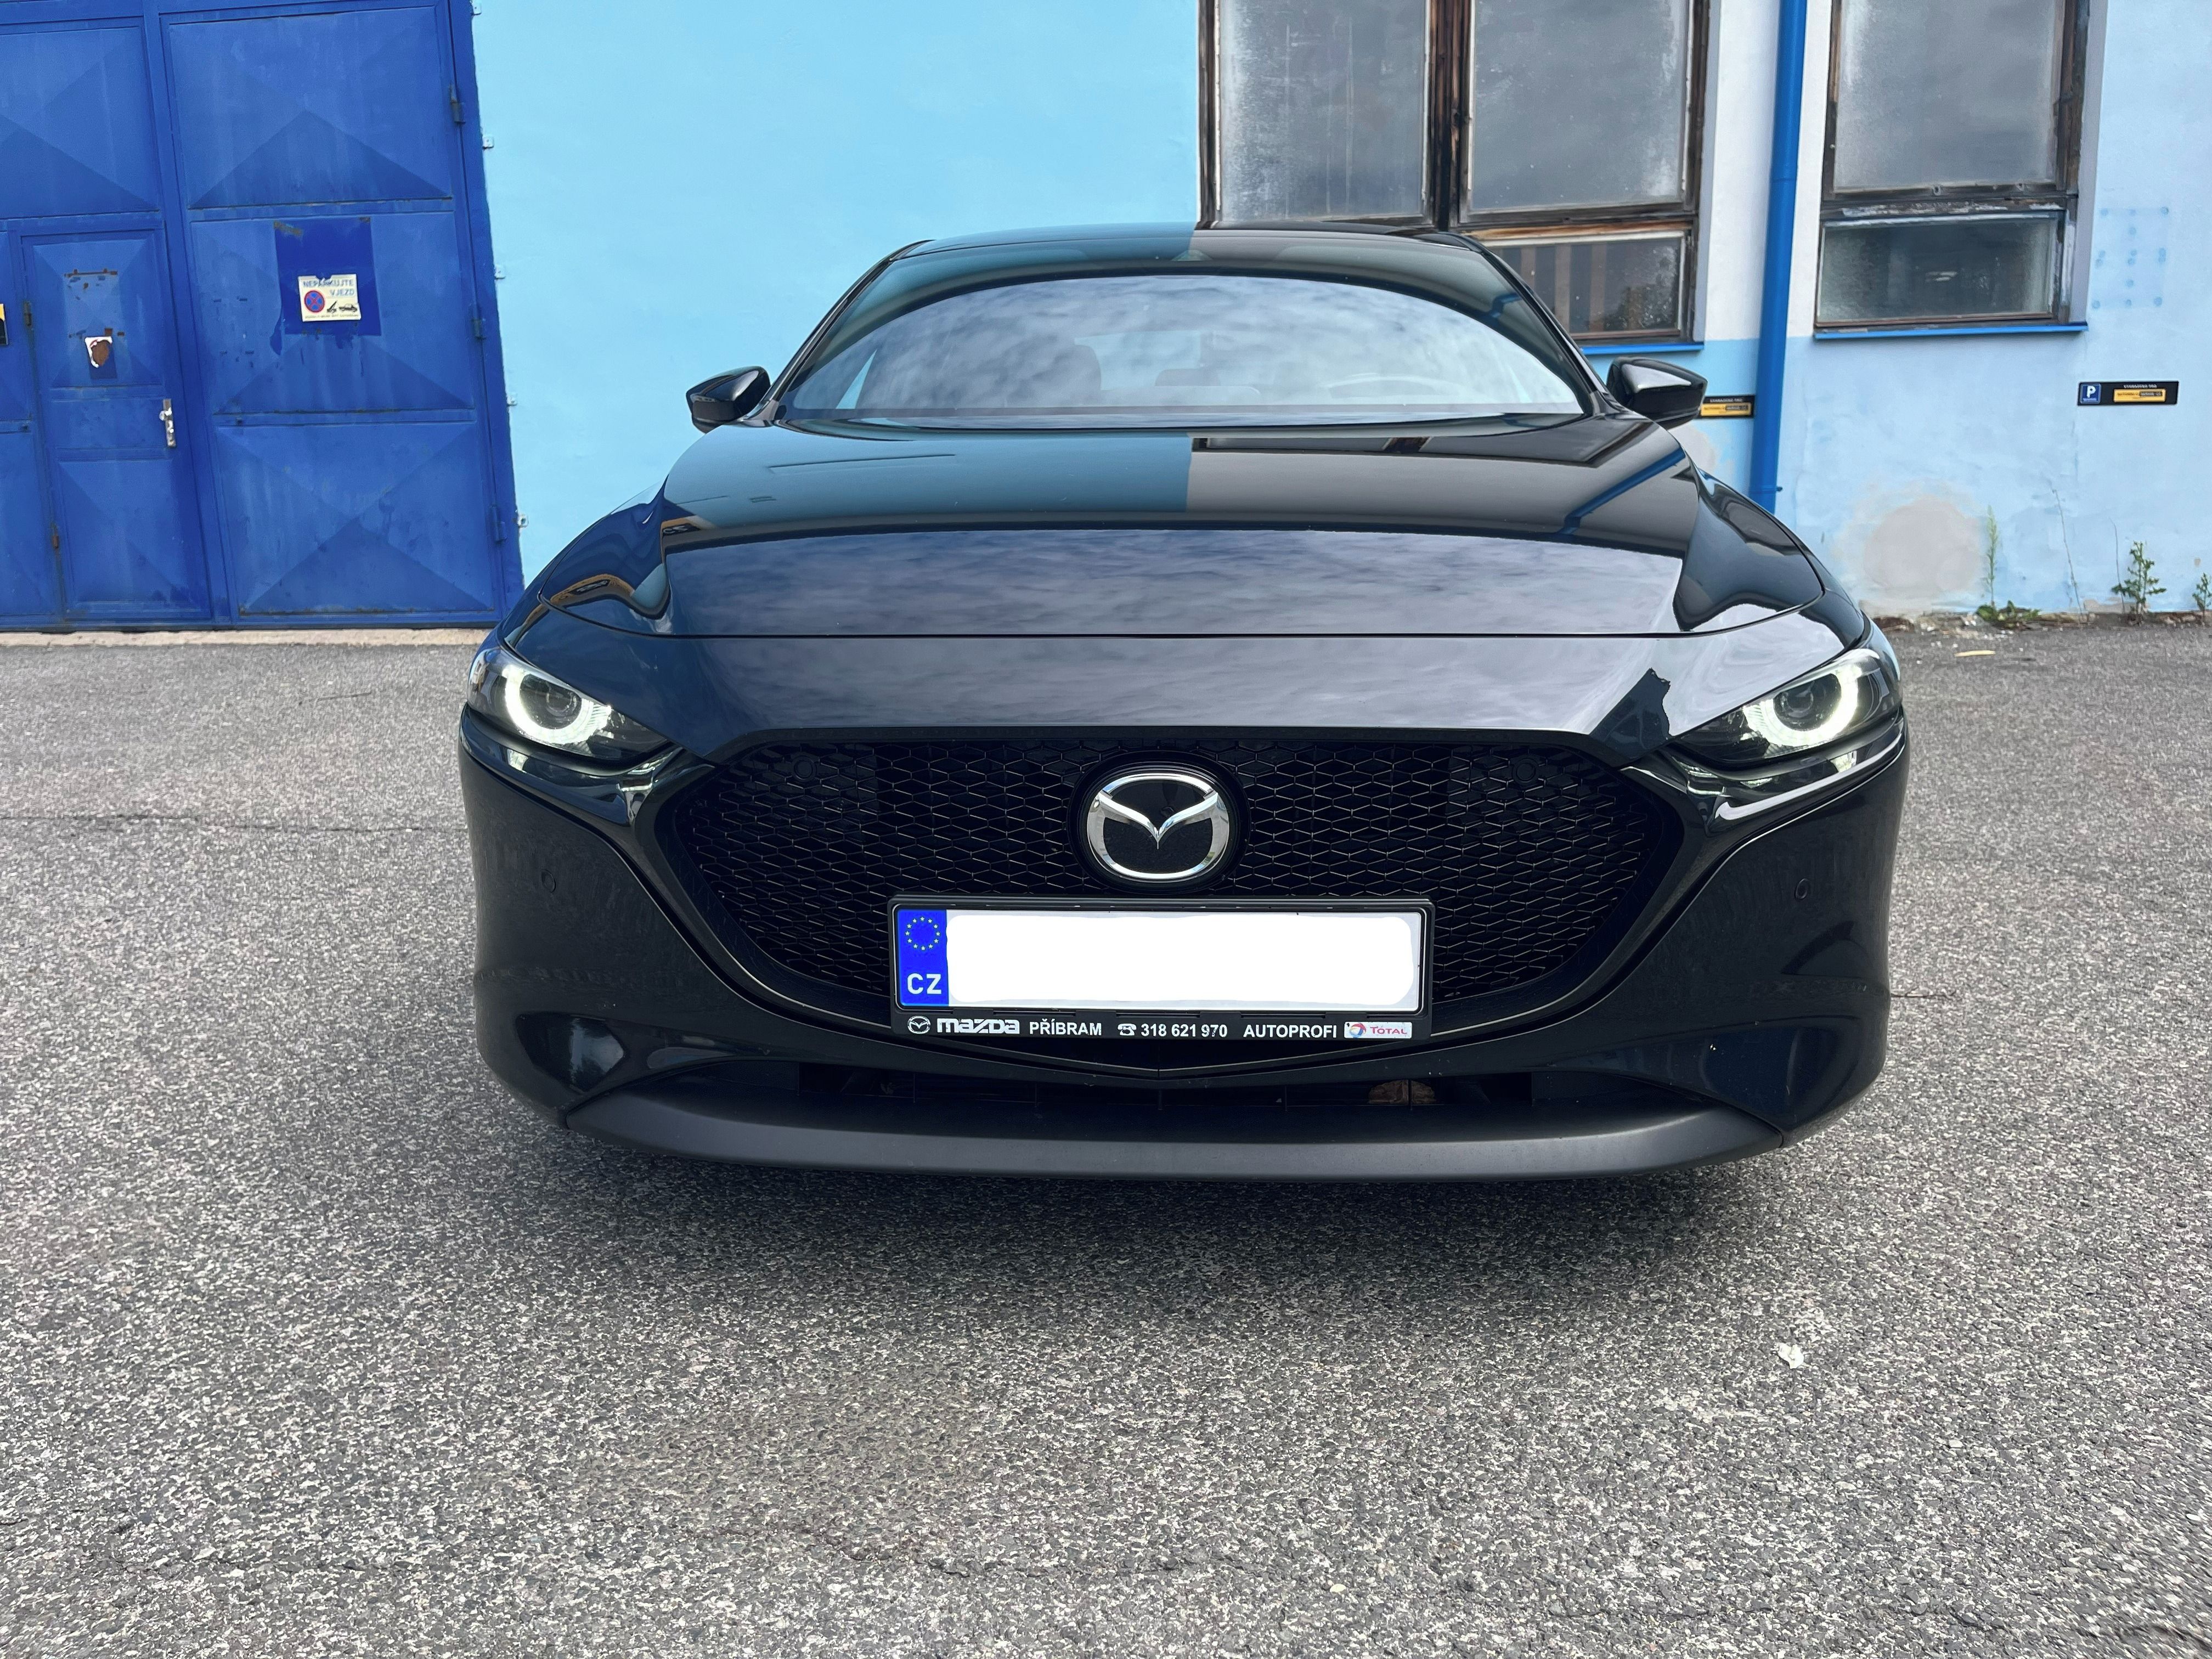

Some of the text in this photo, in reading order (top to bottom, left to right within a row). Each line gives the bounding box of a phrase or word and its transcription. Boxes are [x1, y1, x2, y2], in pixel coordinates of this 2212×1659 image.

[2086, 386, 2096, 398] P
[907, 973, 941, 994] CZ
[1029, 1019, 1102, 1036] PŘÍBRAM
[1141, 1023, 1167, 1036] 318
[1171, 1024, 1196, 1037] 621
[1201, 1024, 1228, 1037] 970
[1243, 1024, 1336, 1038] AUTOPROFI
[1370, 1026, 1407, 1035] TOTAL
